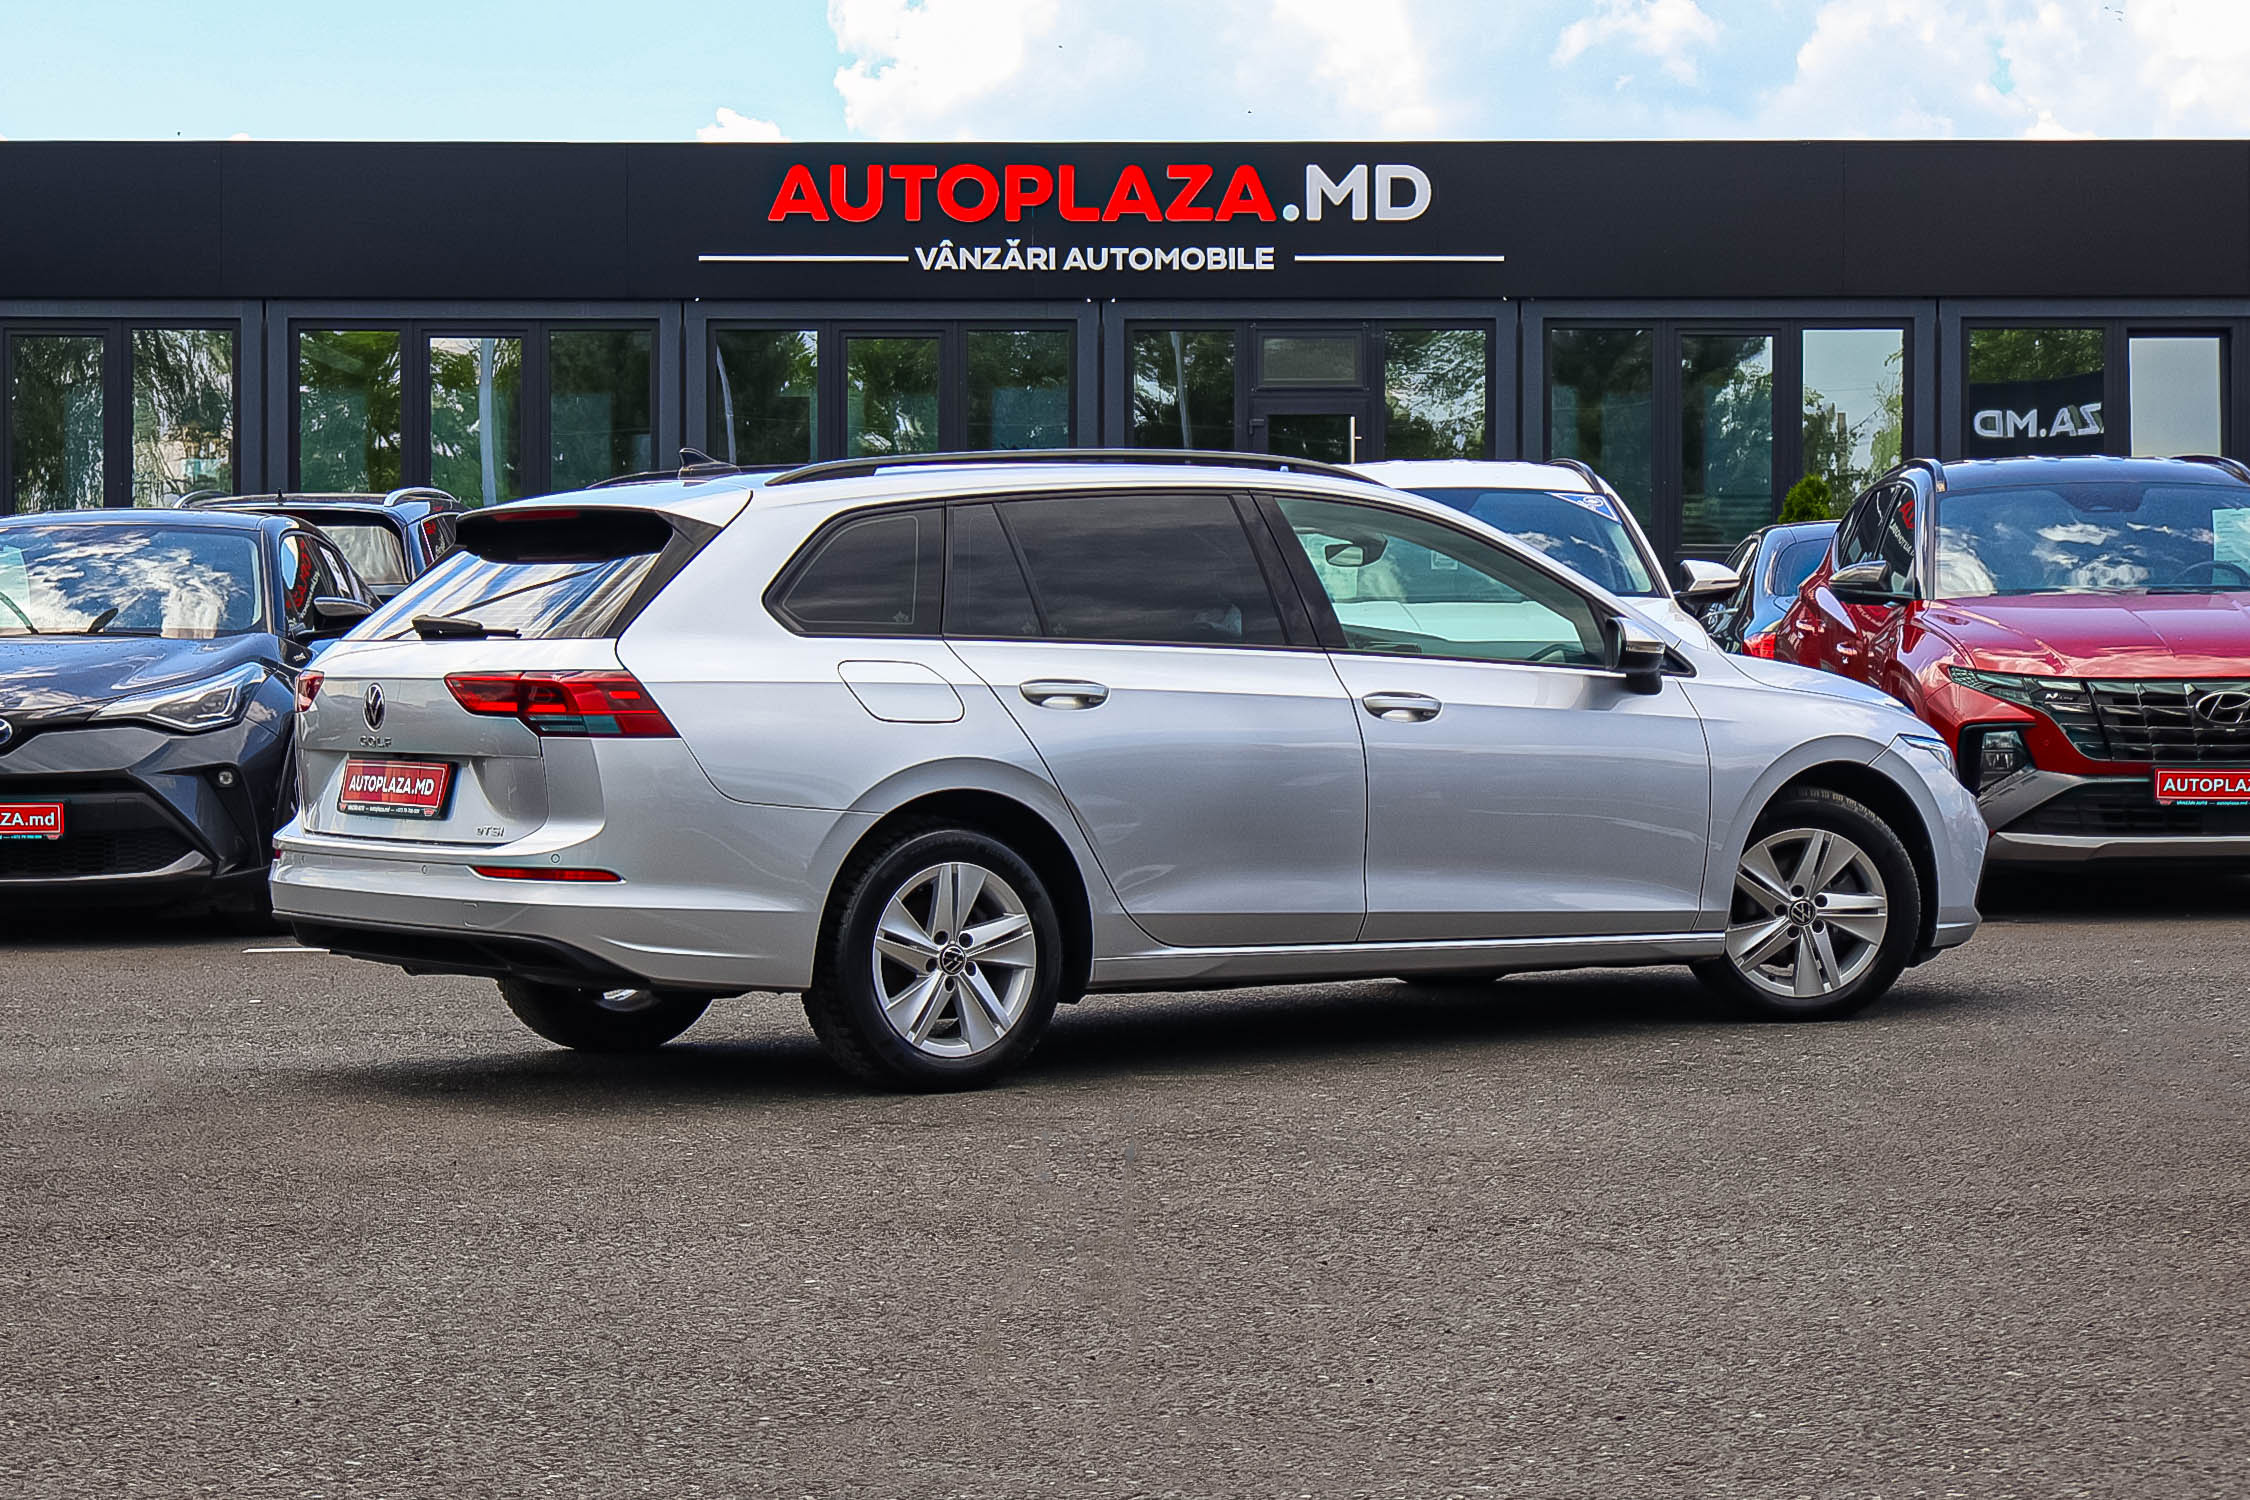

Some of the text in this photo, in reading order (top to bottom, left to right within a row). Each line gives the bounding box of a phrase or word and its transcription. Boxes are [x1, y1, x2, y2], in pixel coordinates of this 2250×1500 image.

[768, 164, 1432, 222] AUTOPLAZA.MD
[915, 239, 1275, 270] VÂNZĂRI AUTOMOBILE
[348, 774, 435, 796] AUTOPLAZA.MD
